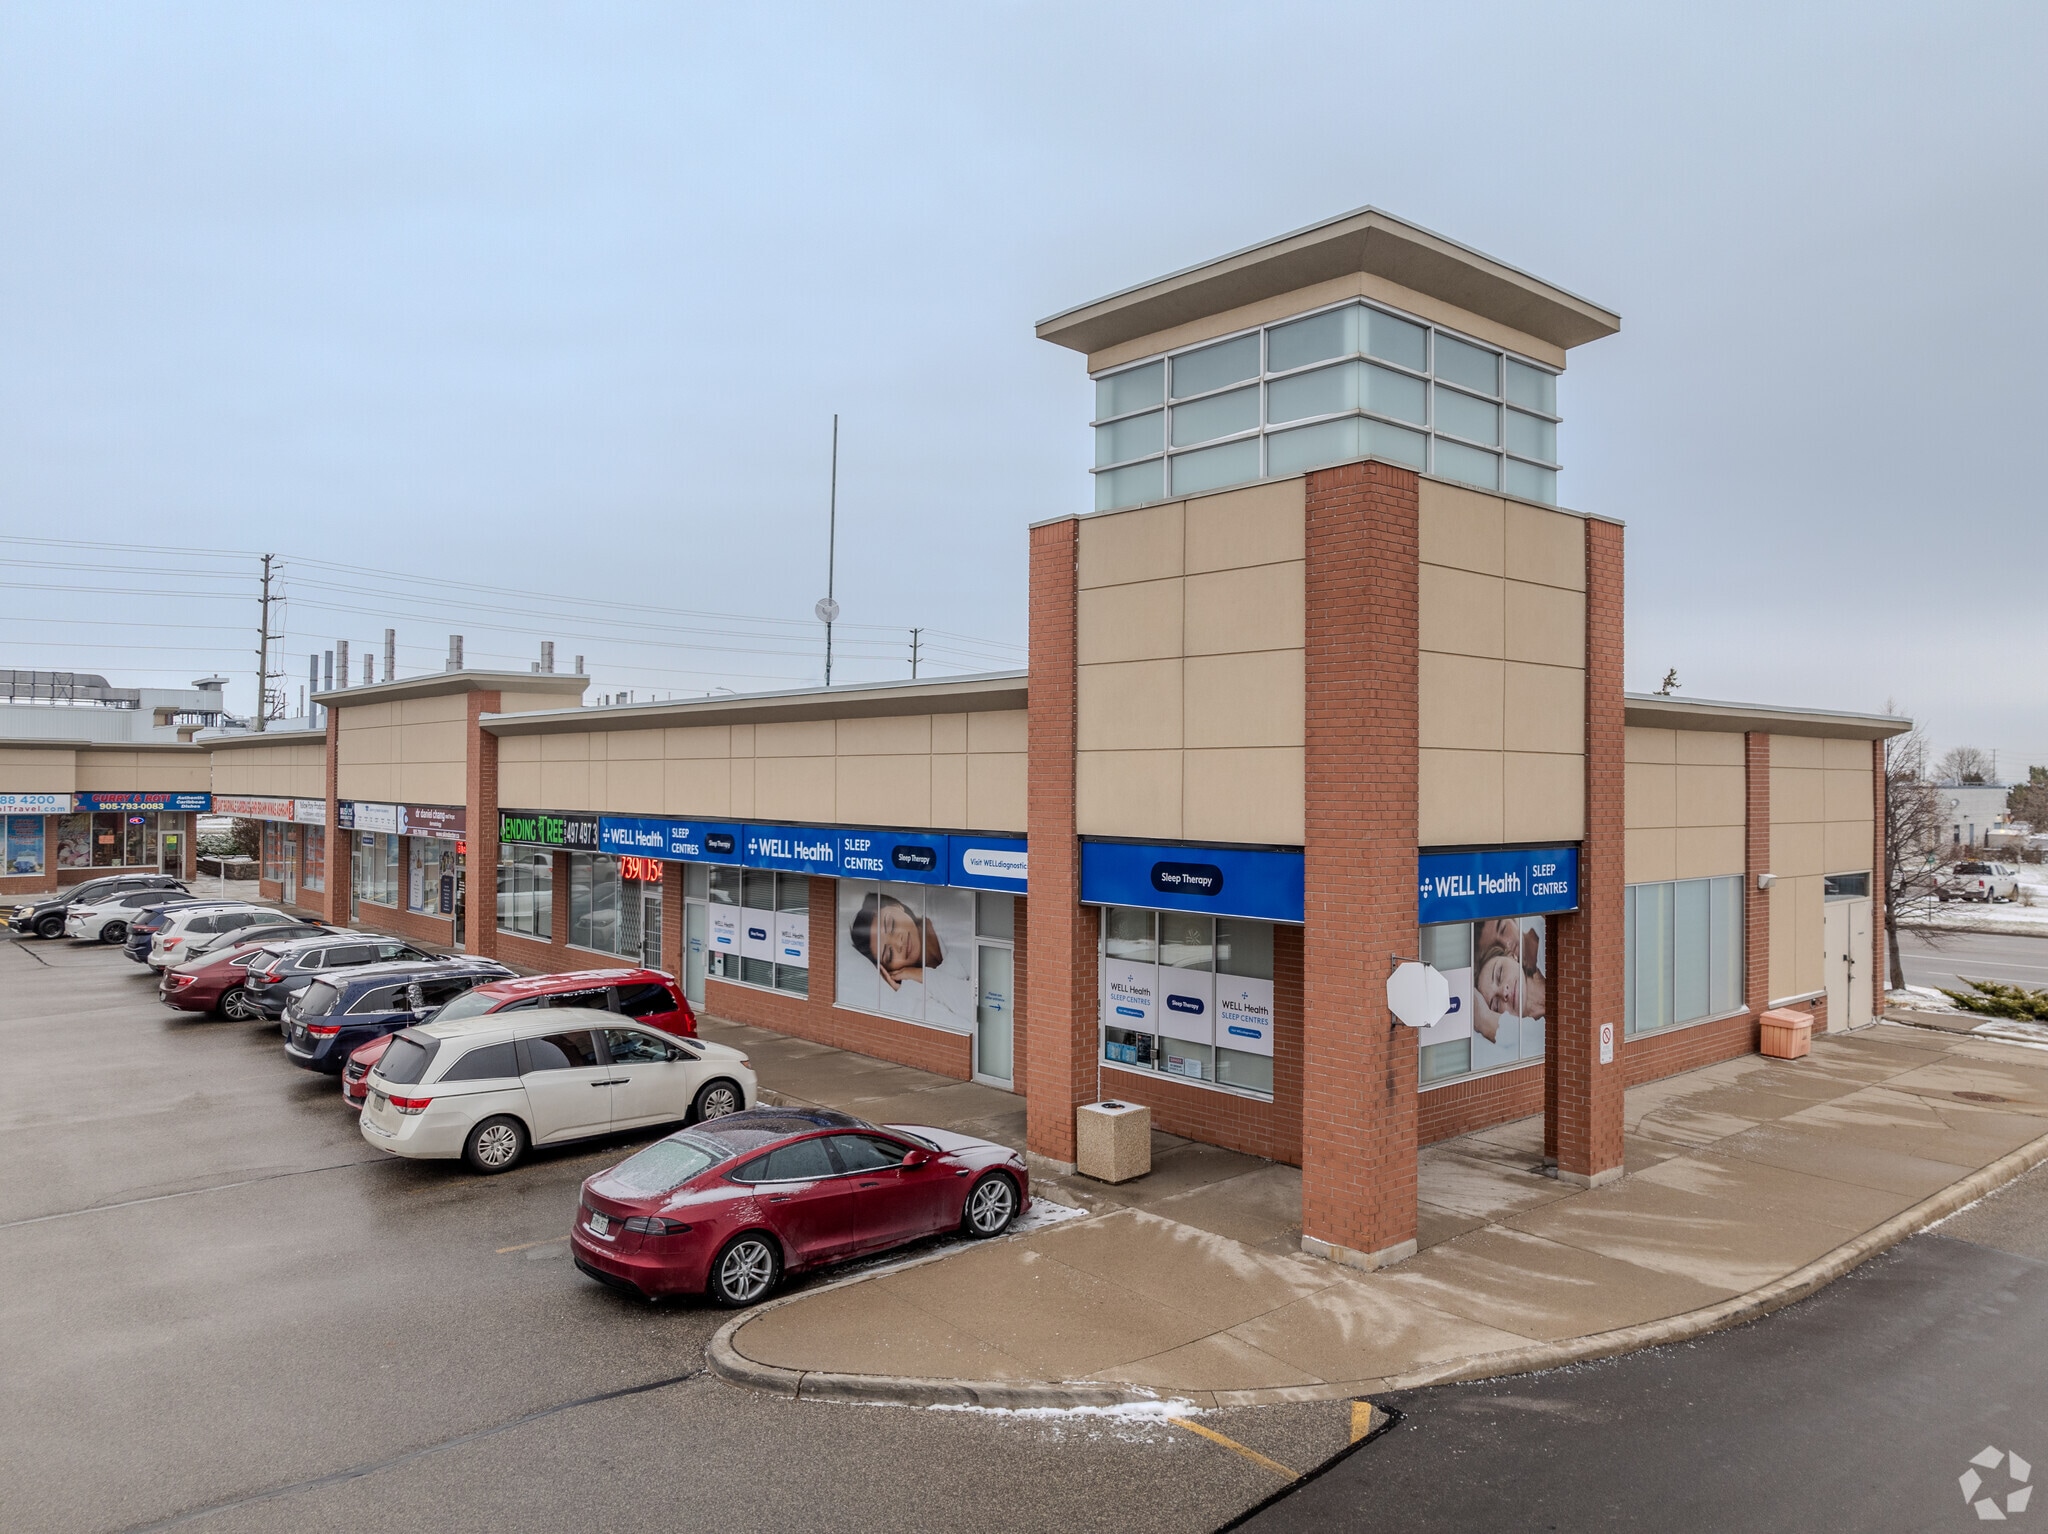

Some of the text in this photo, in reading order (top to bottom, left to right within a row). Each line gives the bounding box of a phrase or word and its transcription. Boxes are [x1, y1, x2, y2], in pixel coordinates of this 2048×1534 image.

[20, 796, 55, 804] 4200
[92, 794, 171, 802] CURRY & ROTI
[538, 816, 563, 844] TREE
[567, 822, 579, 843] 497
[579, 822, 592, 844] 497
[672, 827, 690, 838] SLEEP
[611, 828, 663, 847] WELL Health
[844, 838, 871, 851] SLEEP
[672, 843, 699, 855] CENTRES
[759, 838, 833, 861] WELL Health
[844, 857, 883, 871] CENTRES
[898, 853, 930, 864] Sleep Therapy
[970, 858, 982, 866] Visit
[1532, 863, 1556, 877] SLEEP
[1161, 872, 1213, 888] Sleep Therapy
[1435, 872, 1521, 898] WELL Health
[1532, 881, 1568, 896] CENTRES
[1110, 982, 1151, 996] WELL Health
[1110, 993, 1151, 1006] SLEEP CENTRES
[1183, 1001, 1200, 1010] Therapy
[1222, 1000, 1269, 1015] WELL Health
[1222, 1012, 1269, 1025] SLEEP CENTRES
